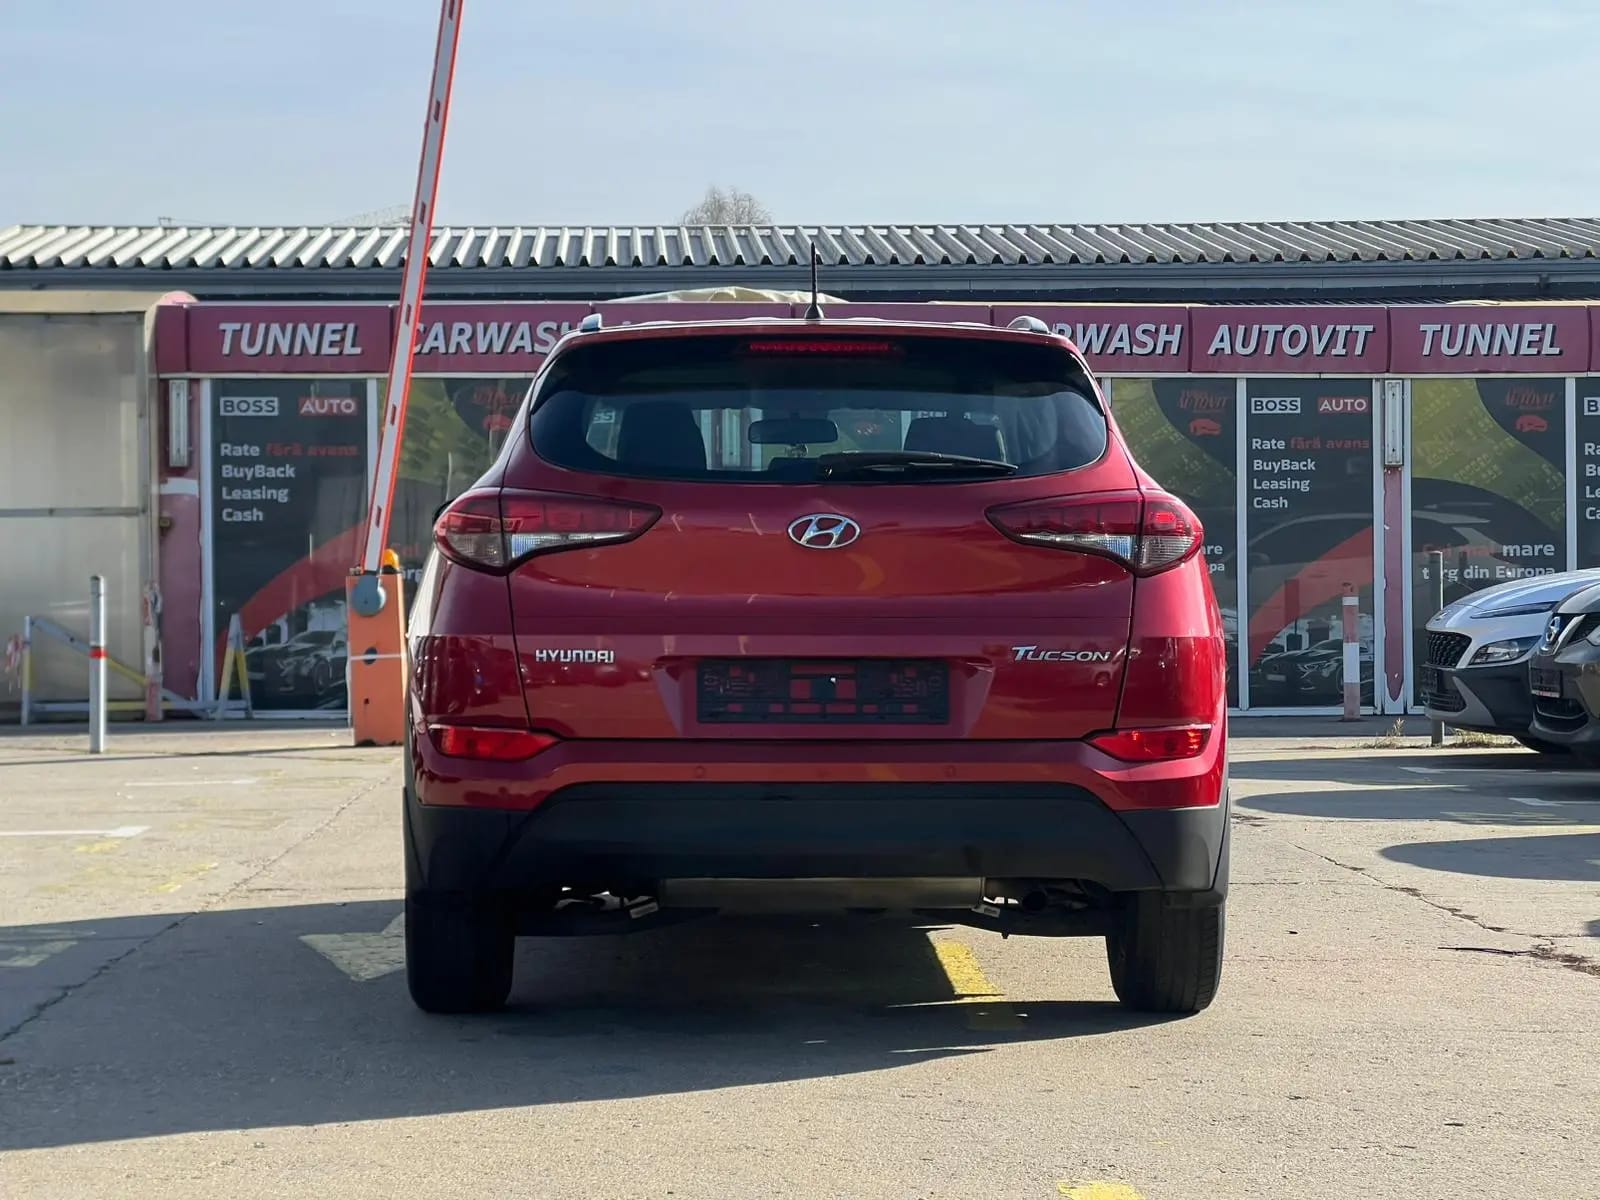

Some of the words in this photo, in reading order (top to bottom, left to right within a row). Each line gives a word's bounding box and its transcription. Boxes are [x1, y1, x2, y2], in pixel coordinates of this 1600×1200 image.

[219, 322, 363, 356] TUNNEL
[1207, 323, 1375, 356] AUTOVIT
[1419, 323, 1561, 356] TUNNEL
[223, 400, 276, 413] BOSS
[301, 400, 356, 413] AUTO
[1253, 399, 1299, 412] BOSS
[1320, 399, 1367, 411] AUTO
[220, 443, 260, 456] Rate
[1252, 438, 1286, 450] Rate
[221, 464, 296, 480] BuyBack
[1253, 459, 1316, 473] BuyBack
[1253, 478, 1310, 492] Leasing
[222, 485, 289, 502] Leasing
[1253, 497, 1288, 509] Cash
[222, 507, 264, 522] Cash
[1502, 543, 1555, 557] mare
[1463, 565, 1489, 579] din
[535, 649, 614, 663] HYUNDAI
